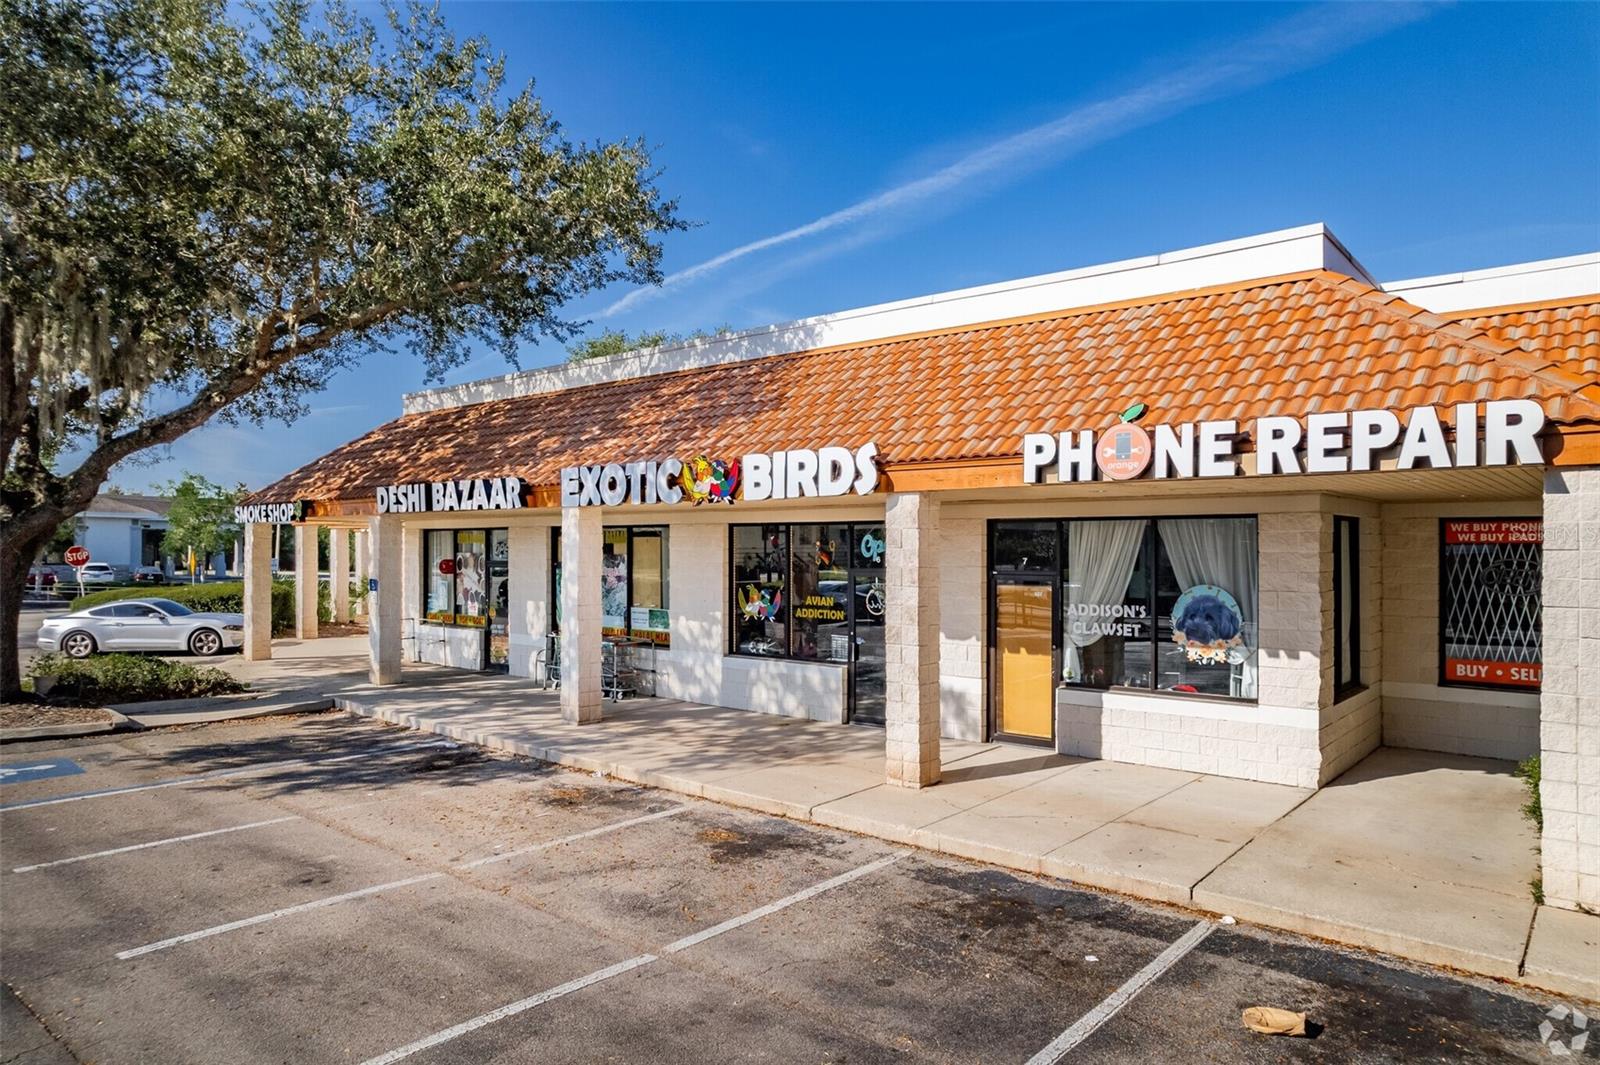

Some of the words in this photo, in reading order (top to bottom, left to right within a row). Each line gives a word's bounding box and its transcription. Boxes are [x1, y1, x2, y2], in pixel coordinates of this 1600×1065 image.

[1256, 399, 1545, 475] REPAIR
[1107, 461, 1139, 472] orange
[561, 457, 684, 507] EXOTIC
[743, 441, 878, 501] BIRDS
[376, 483, 426, 514] DESHI
[431, 477, 522, 512] BAZAAR
[234, 504, 267, 524] SMOKE
[267, 503, 294, 523] SHOP
[1450, 523, 1470, 532] WE
[1473, 523, 1497, 532] BUY
[1457, 533, 1476, 541] WE
[1480, 533, 1504, 541] BUY
[67, 550, 89, 562] STOP
[1022, 557, 1028, 565] 7
[805, 595, 834, 607] AVIAN
[795, 609, 845, 621] ADDICTION
[1067, 603, 1147, 619] ADDISON'S
[1072, 621, 1142, 637] CLAWSET
[1456, 664, 1488, 677] BUY
